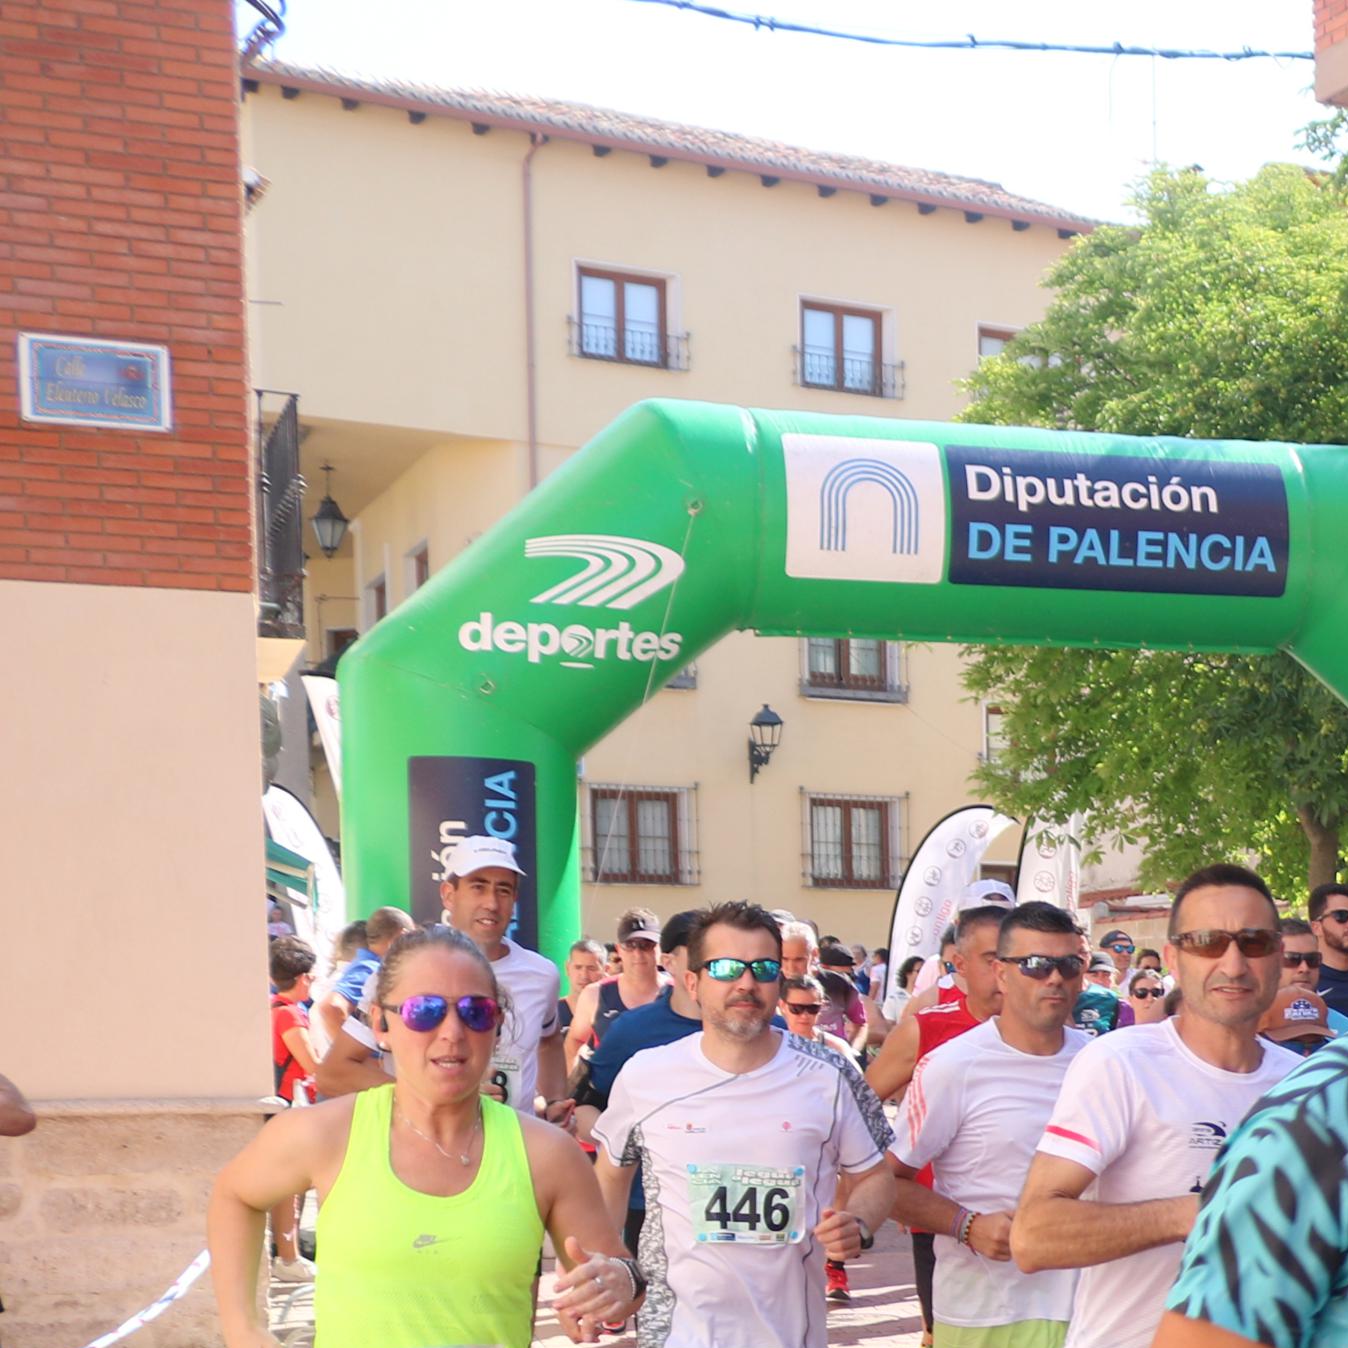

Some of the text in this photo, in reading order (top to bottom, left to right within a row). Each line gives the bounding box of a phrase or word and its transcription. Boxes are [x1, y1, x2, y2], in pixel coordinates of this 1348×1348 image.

[964, 464, 1218, 514] Diputación
[967, 521, 1278, 573] DE PALENCIA
[458, 612, 683, 664] deportes
[705, 1186, 790, 1231] 446
